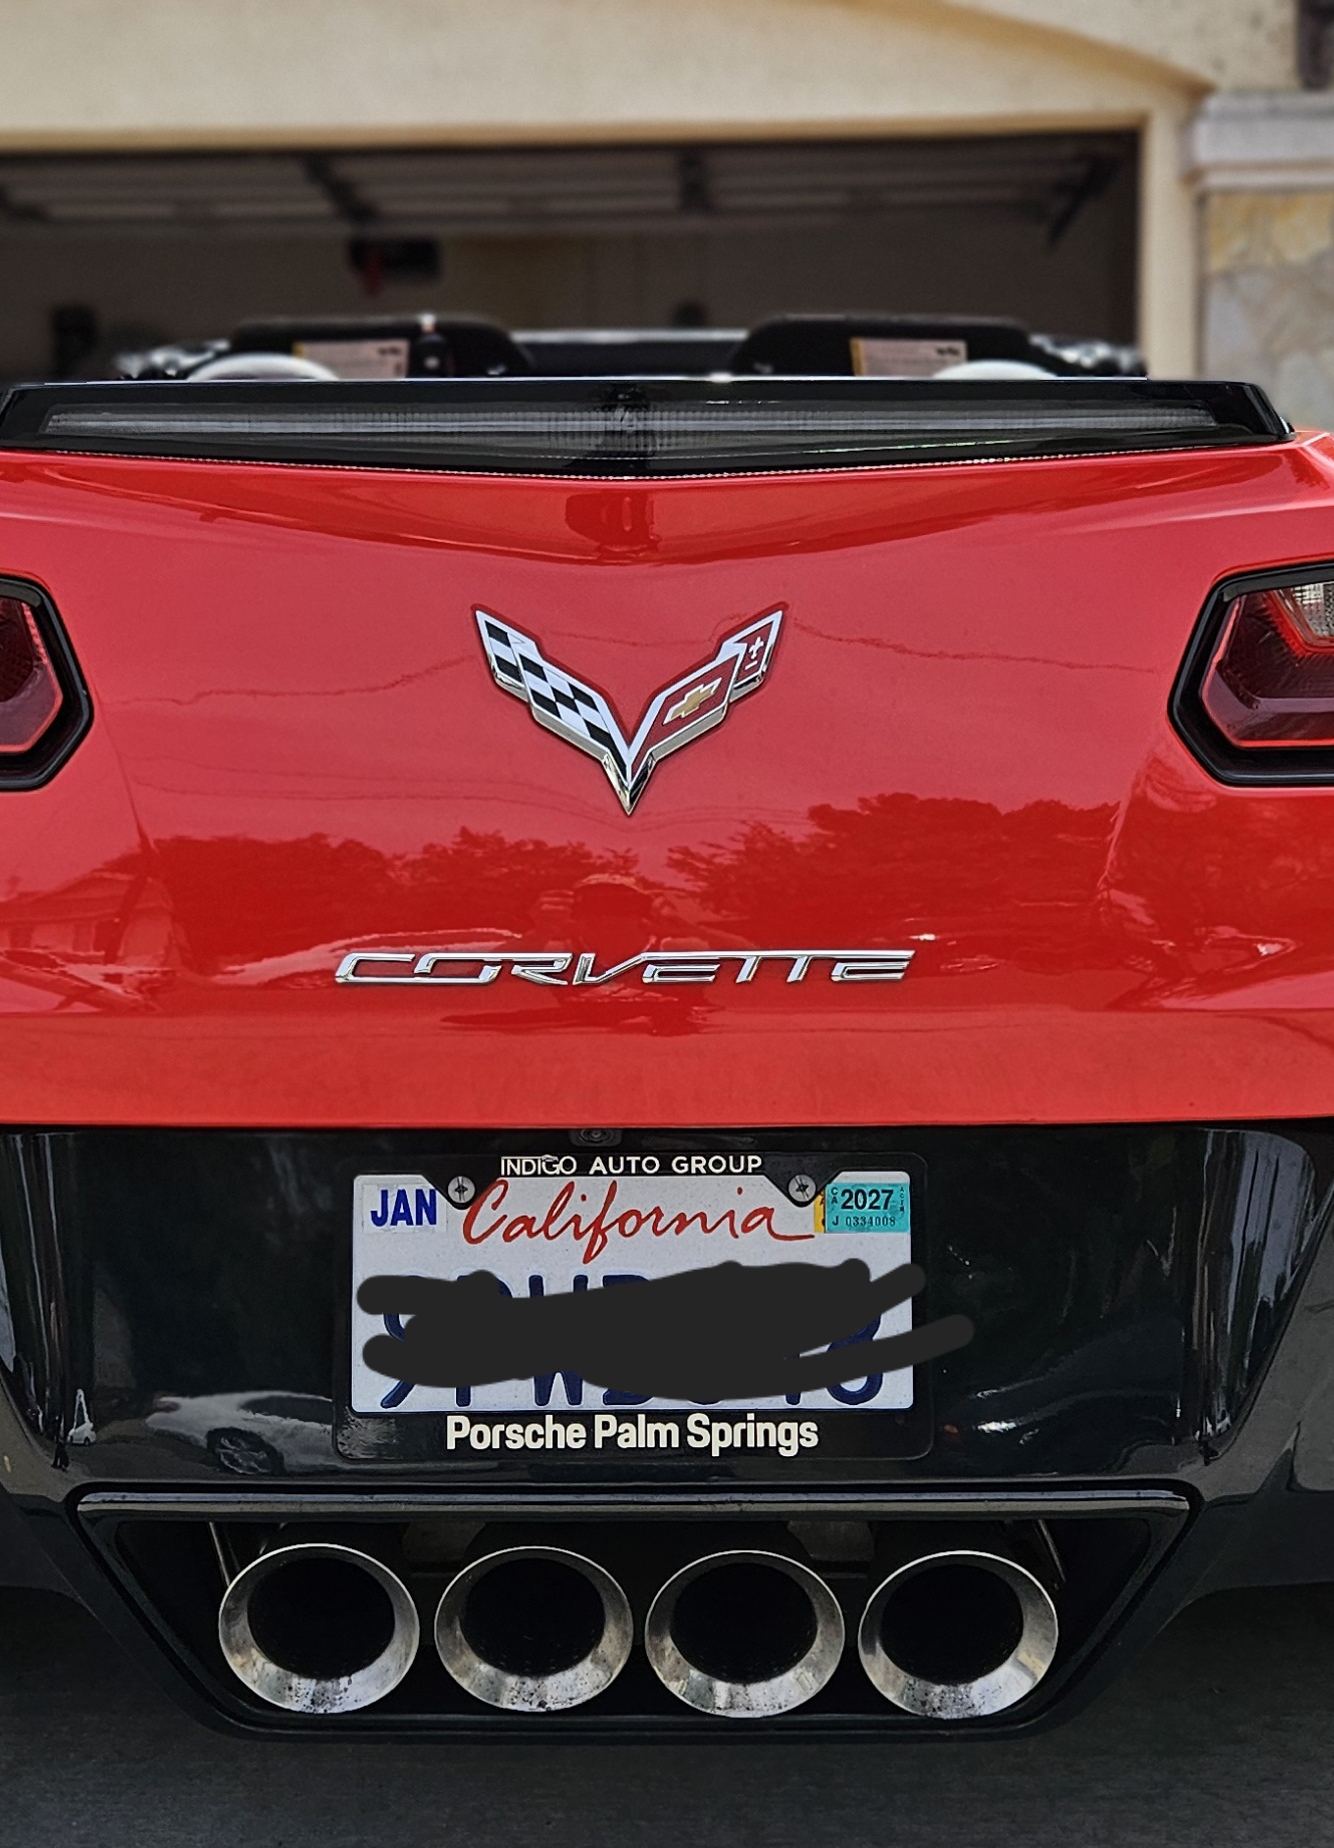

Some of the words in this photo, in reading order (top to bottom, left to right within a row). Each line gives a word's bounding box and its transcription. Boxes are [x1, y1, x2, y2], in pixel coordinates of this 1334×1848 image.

[334, 949, 915, 986] CORVETTE
[501, 1155, 578, 1176] INDIGO
[588, 1156, 661, 1175] AUTO
[671, 1155, 763, 1175] GROUP
[370, 1188, 437, 1227] JAN
[841, 1188, 894, 1210] 2027
[462, 1178, 815, 1265] California
[446, 1414, 587, 1450] Porsche
[594, 1413, 679, 1449] Palm
[686, 1413, 819, 1457] Springs
